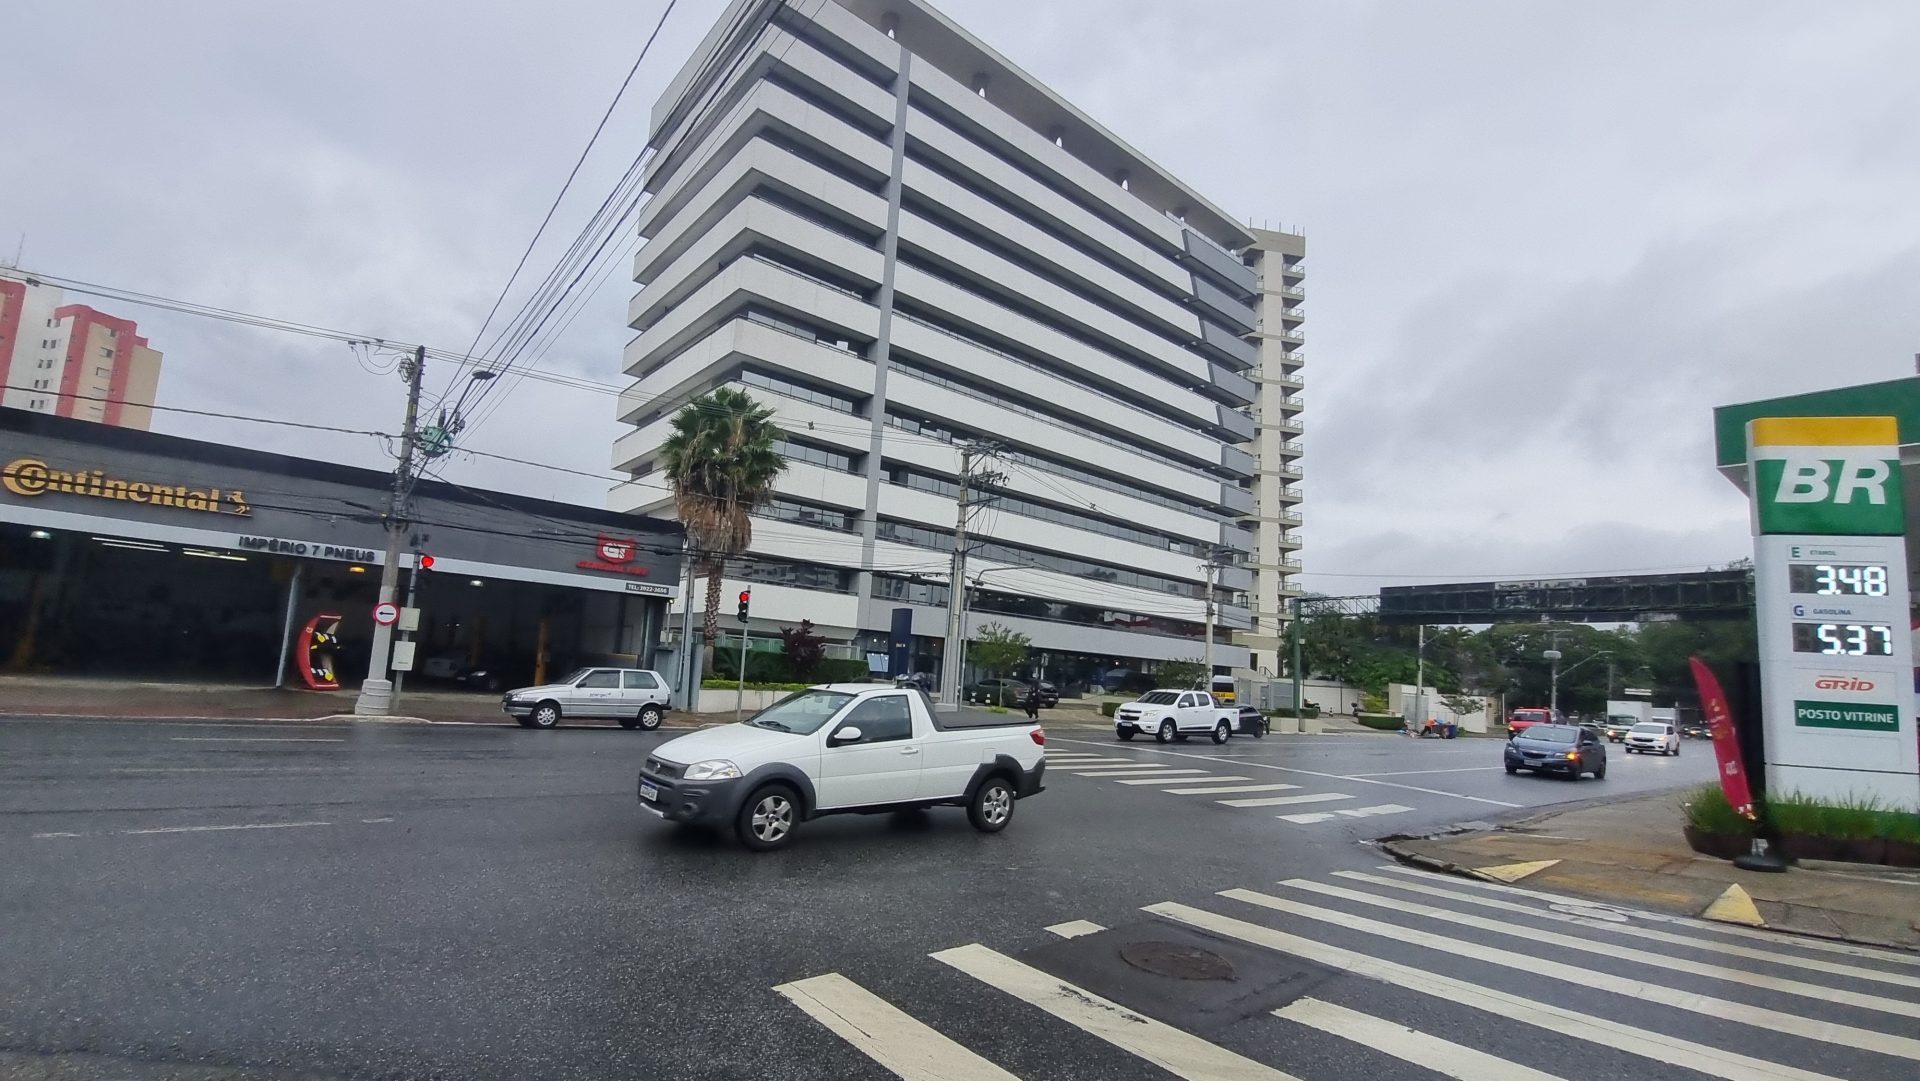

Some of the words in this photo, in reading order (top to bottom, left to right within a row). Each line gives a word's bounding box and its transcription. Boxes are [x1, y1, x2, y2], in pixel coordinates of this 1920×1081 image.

[2, 458, 219, 512] Continental
[1775, 459, 1889, 505] BR
[239, 535, 307, 555] IMPÉRIO
[312, 545, 321, 556] 7
[324, 546, 375, 562] PNEUS
[1791, 546, 1801, 558] E
[1815, 565, 1887, 597] 3.48
[1793, 604, 1804, 617] G
[1813, 608, 1852, 616] GASOLINA
[1817, 624, 1892, 656] 5.37
[1798, 709, 1840, 721] POSTO
[1843, 711, 1895, 724] VITRINE
